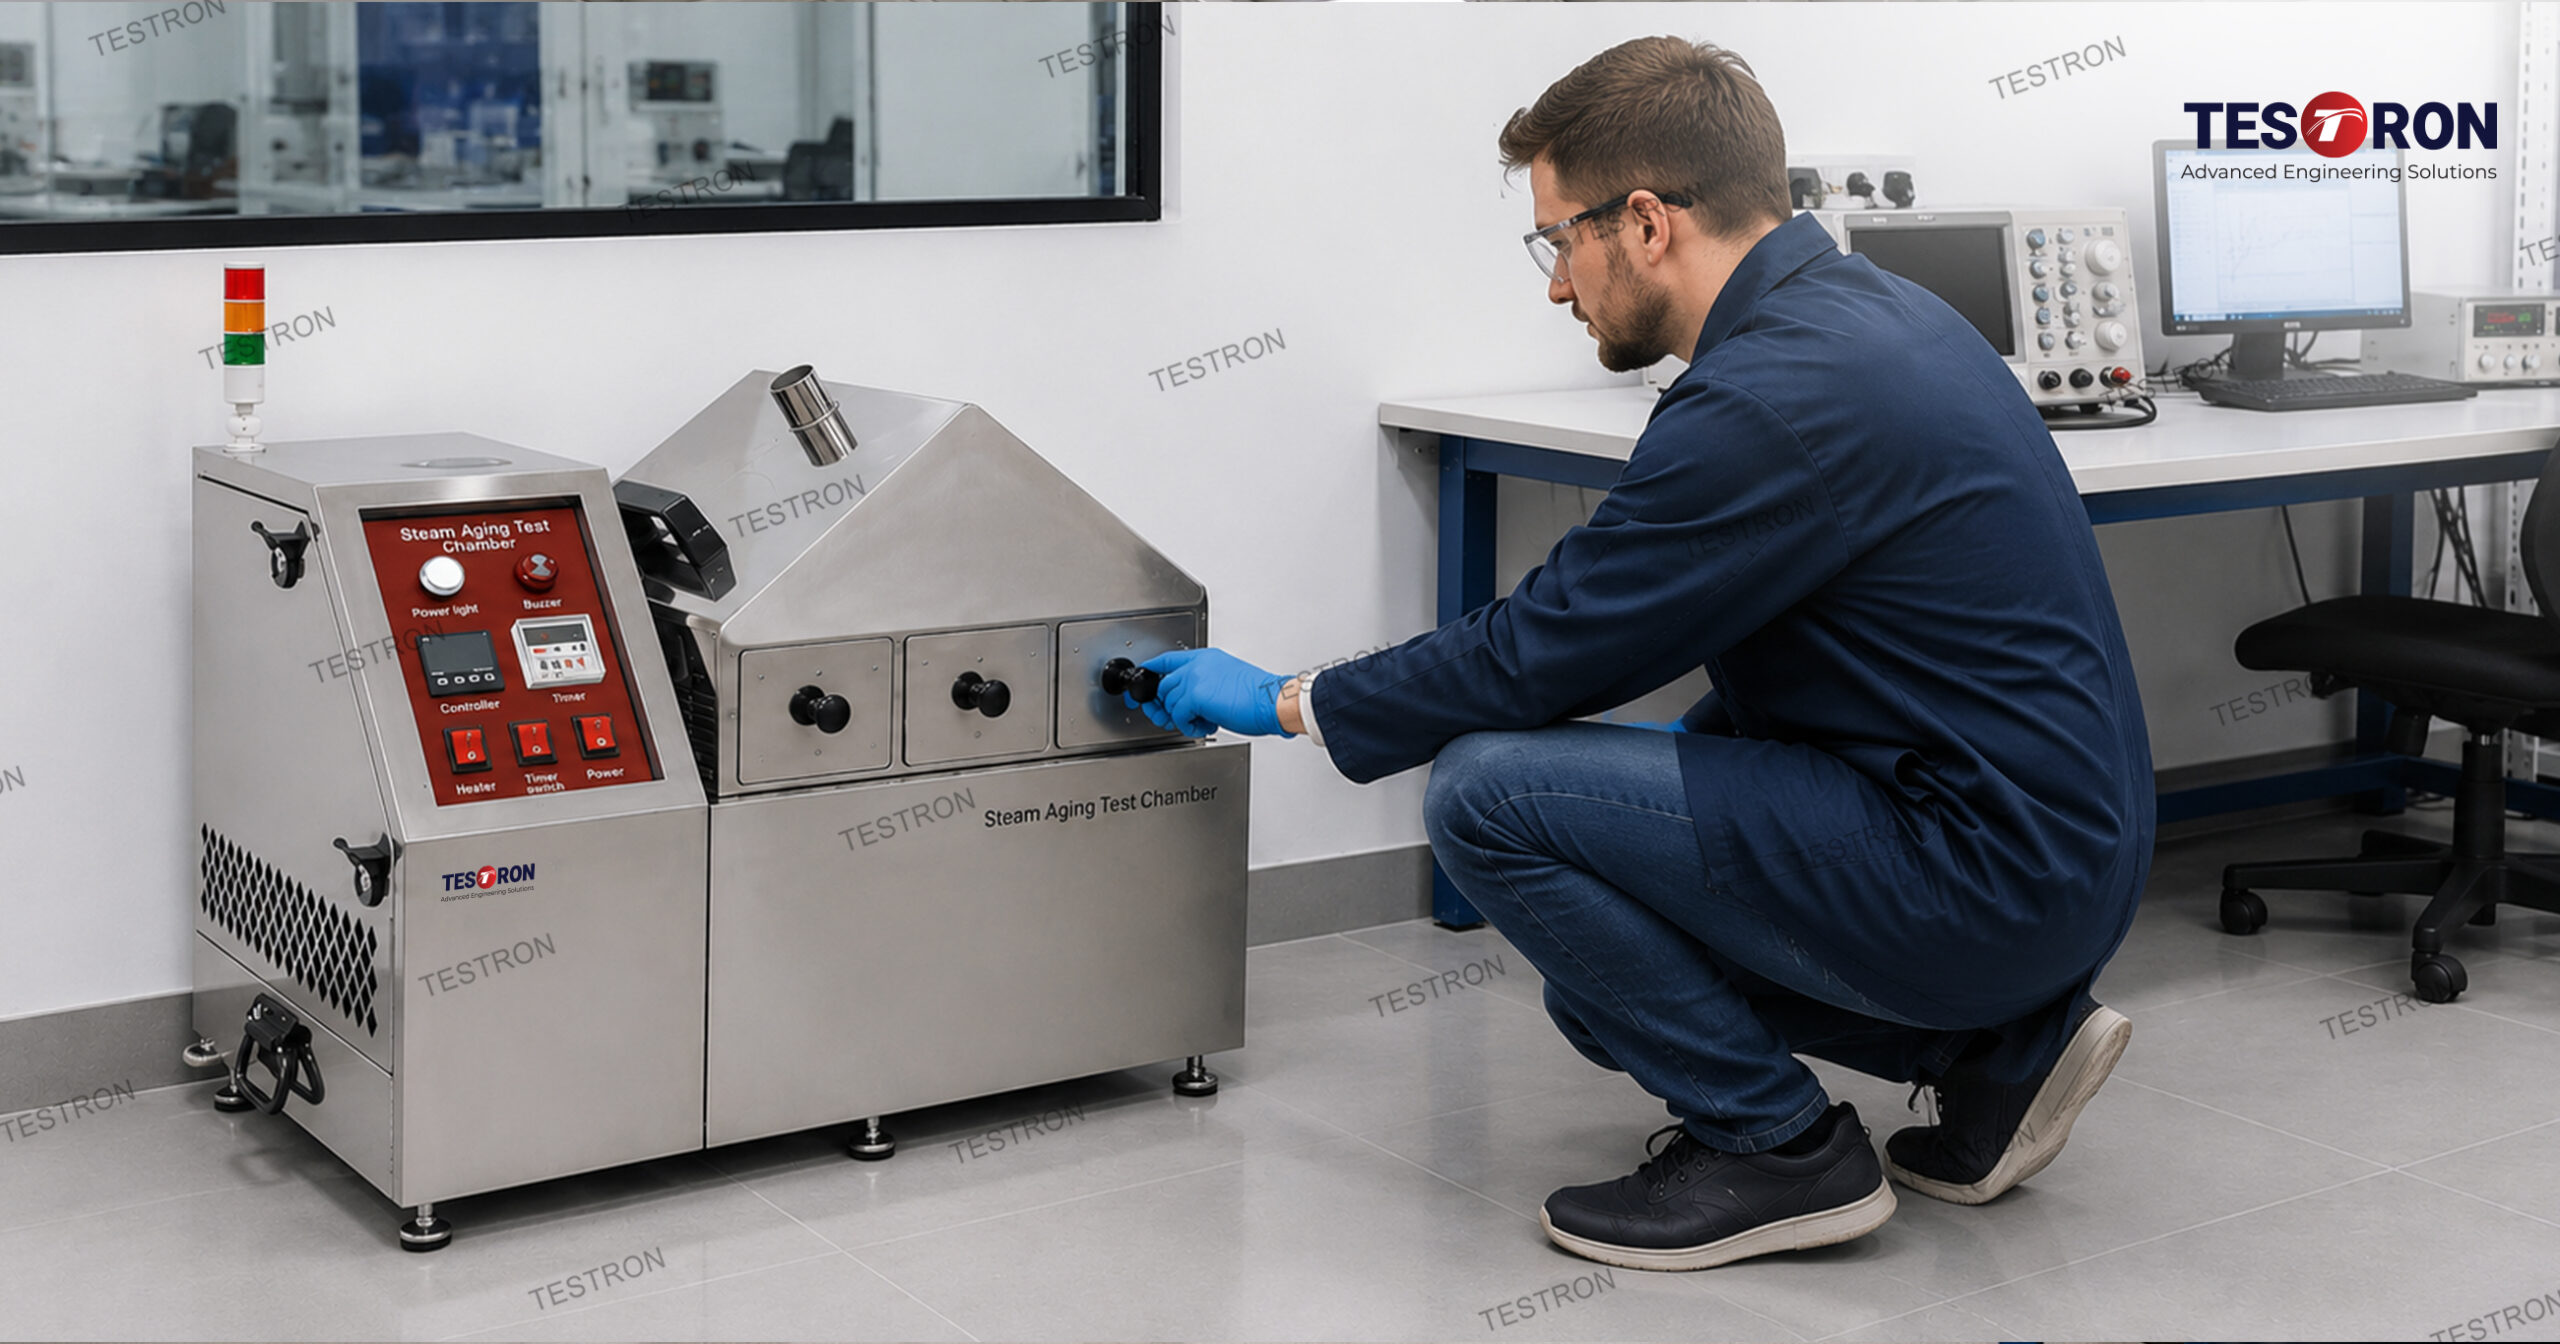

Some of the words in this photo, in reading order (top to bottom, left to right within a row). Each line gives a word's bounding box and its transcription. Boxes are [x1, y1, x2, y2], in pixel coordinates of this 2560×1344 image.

[400, 527, 456, 542] Steam
[461, 521, 510, 540] Aging
[514, 519, 551, 534] Test
[442, 538, 516, 553] Chamber
[411, 607, 450, 619] Power
[451, 604, 480, 618] light
[522, 598, 562, 610] Buzzer
[440, 699, 501, 714] Controller
[524, 772, 559, 784] Timer
[586, 767, 625, 780] Power
[456, 781, 497, 796] Heater
[984, 808, 1040, 828] Steam
[1045, 800, 1096, 823] Aging
[1100, 794, 1136, 814] Test
[1140, 785, 1218, 809] Chamber
[442, 863, 535, 892] TESTRON
[440, 893, 470, 903] Advanced
[471, 889, 507, 899] Engineering
[507, 885, 535, 894] Solutions
